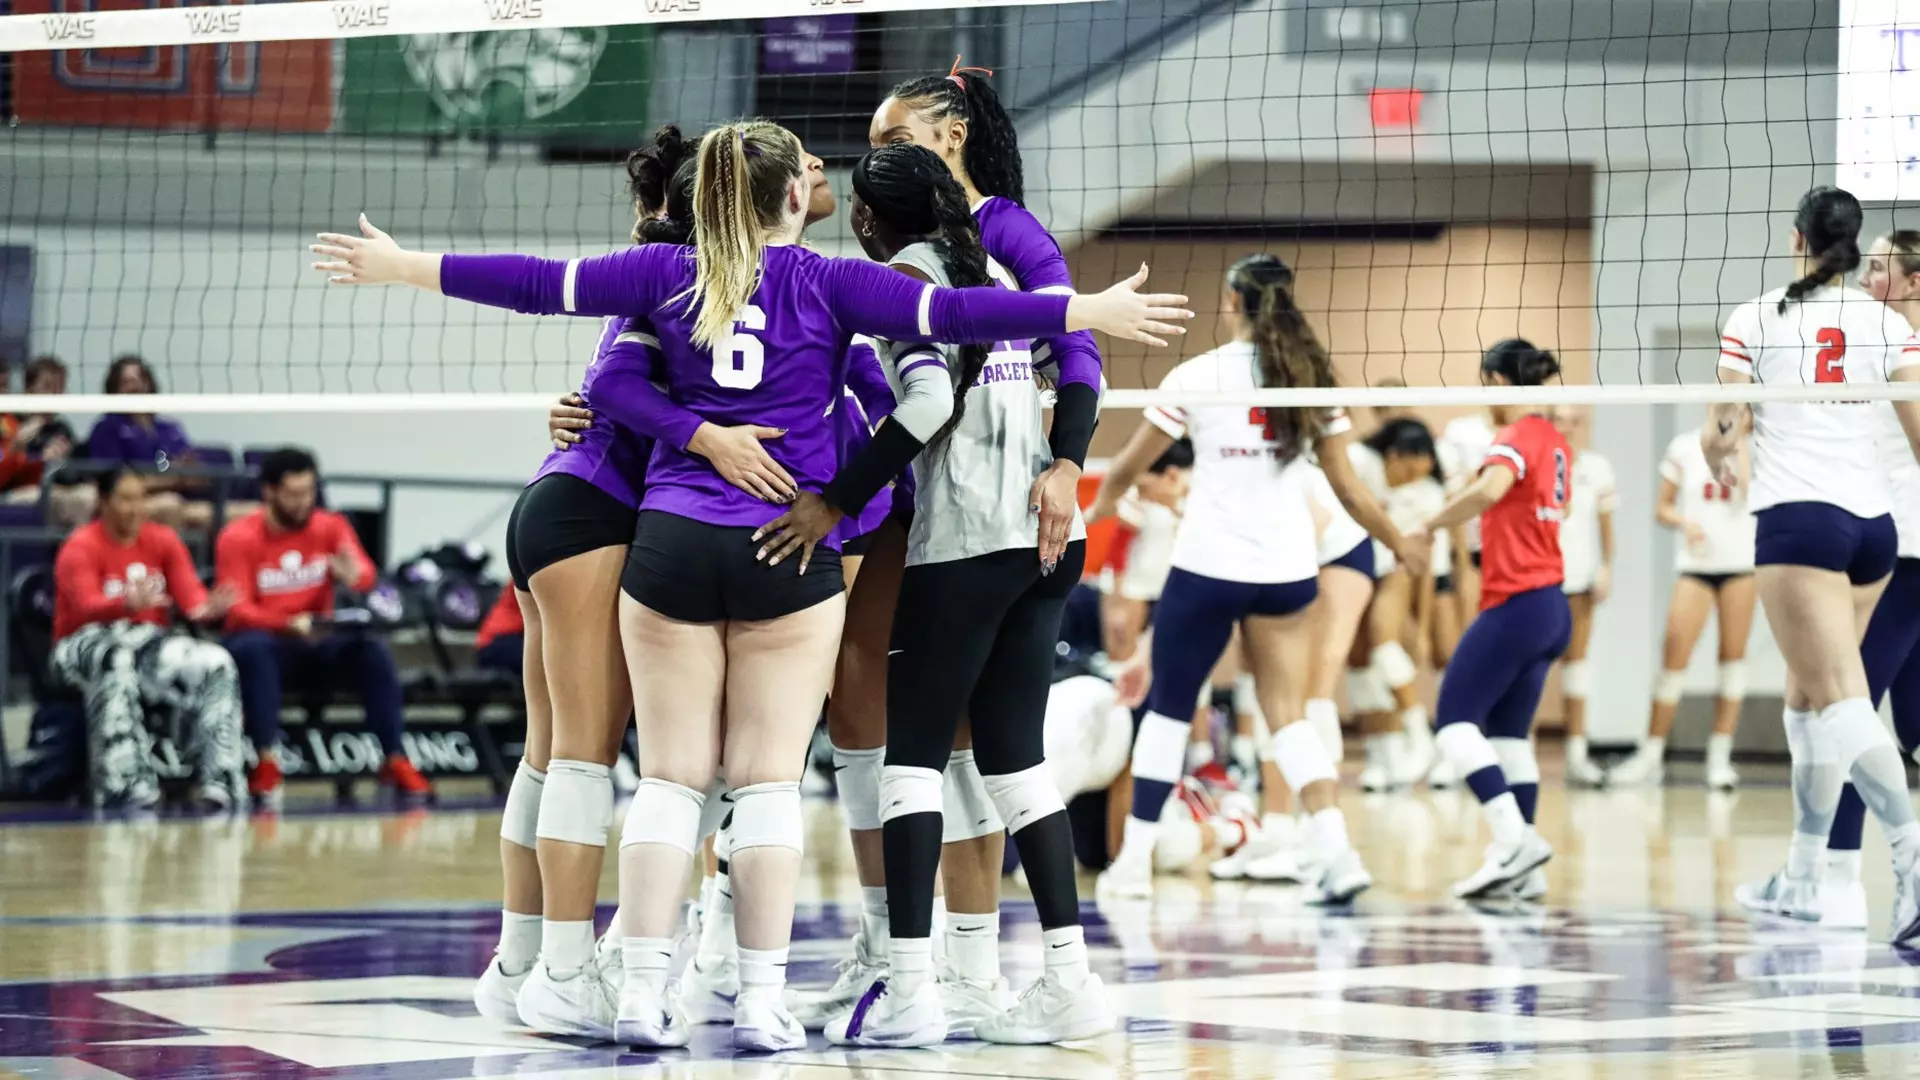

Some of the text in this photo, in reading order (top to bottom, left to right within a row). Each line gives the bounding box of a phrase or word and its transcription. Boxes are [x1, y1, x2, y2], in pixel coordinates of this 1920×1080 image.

[184, 10, 242, 34] WAC
[332, 3, 391, 29] WAC
[484, 0, 543, 20] WAC
[41, 16, 97, 41] WAC
[710, 304, 767, 391] 6
[1814, 327, 1846, 383] 2
[972, 362, 1034, 388] ARLET
